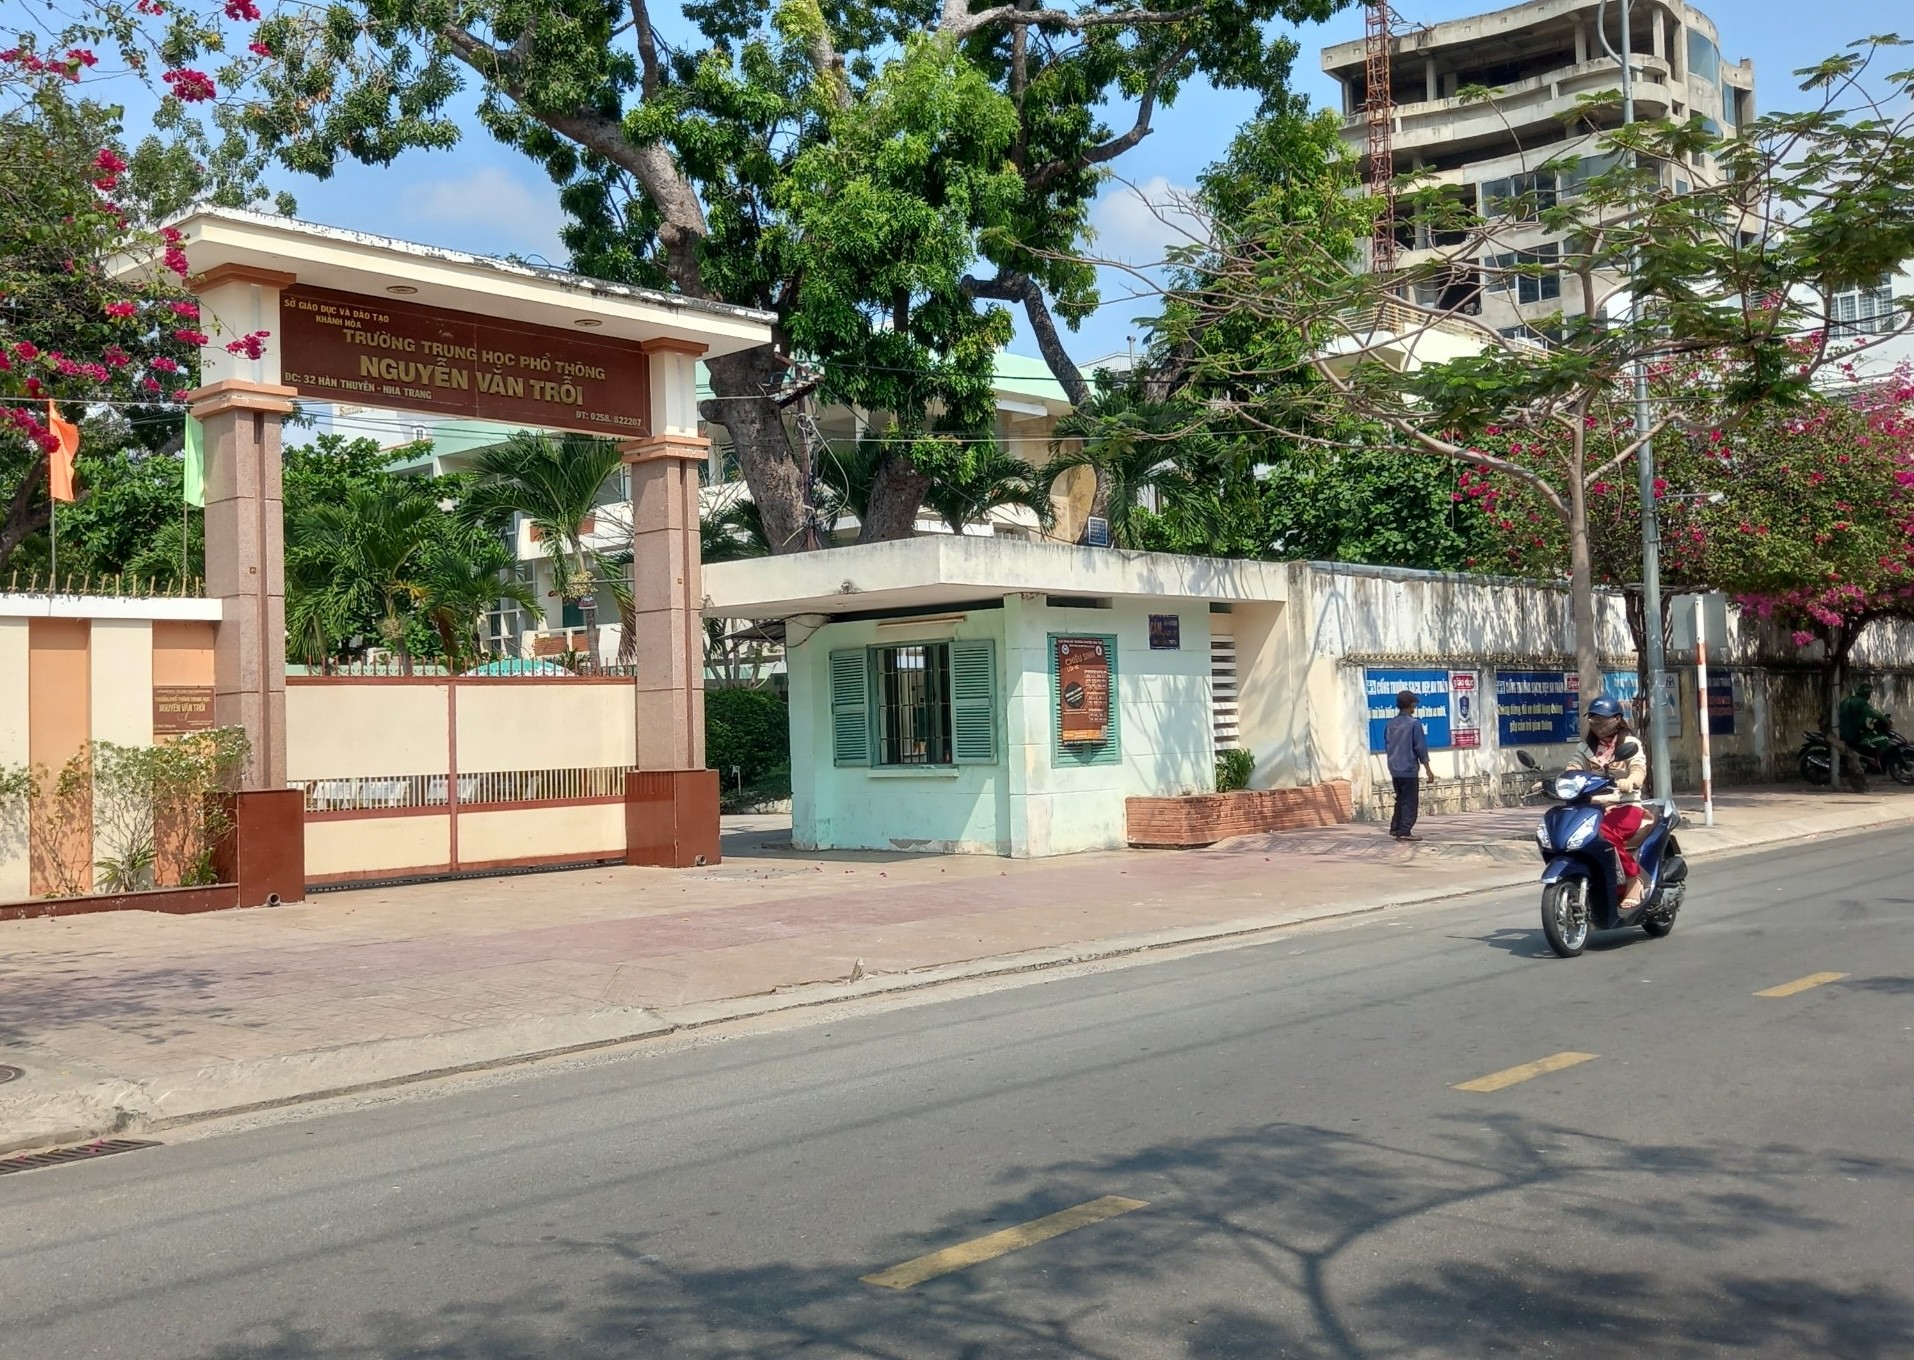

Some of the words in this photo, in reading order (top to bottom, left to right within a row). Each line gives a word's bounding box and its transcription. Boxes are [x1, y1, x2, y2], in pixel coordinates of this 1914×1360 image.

[284, 297, 296, 308] SỞ
[299, 300, 318, 312] GIÁO
[340, 306, 351, 317] VÀ
[353, 308, 370, 320] ĐÀO
[372, 313, 389, 324] TẠO
[316, 313, 343, 326] KHÁNH
[345, 318, 362, 329] HÒA
[343, 329, 416, 352] TRƯỜNG
[421, 341, 477, 361] TRUNG
[482, 351, 516, 367] HỌC
[520, 353, 550, 372] PHỔ
[555, 361, 606, 380] THÔNG
[303, 375, 316, 385] 32
[318, 375, 338, 388] HÀN
[340, 379, 375, 392] THUYÊN
[383, 385, 401, 396] NHA
[403, 388, 432, 400] TRANG
[359, 356, 469, 391] NGUYỄN
[475, 365, 524, 398] VĂN
[529, 376, 584, 406] TRỖI
